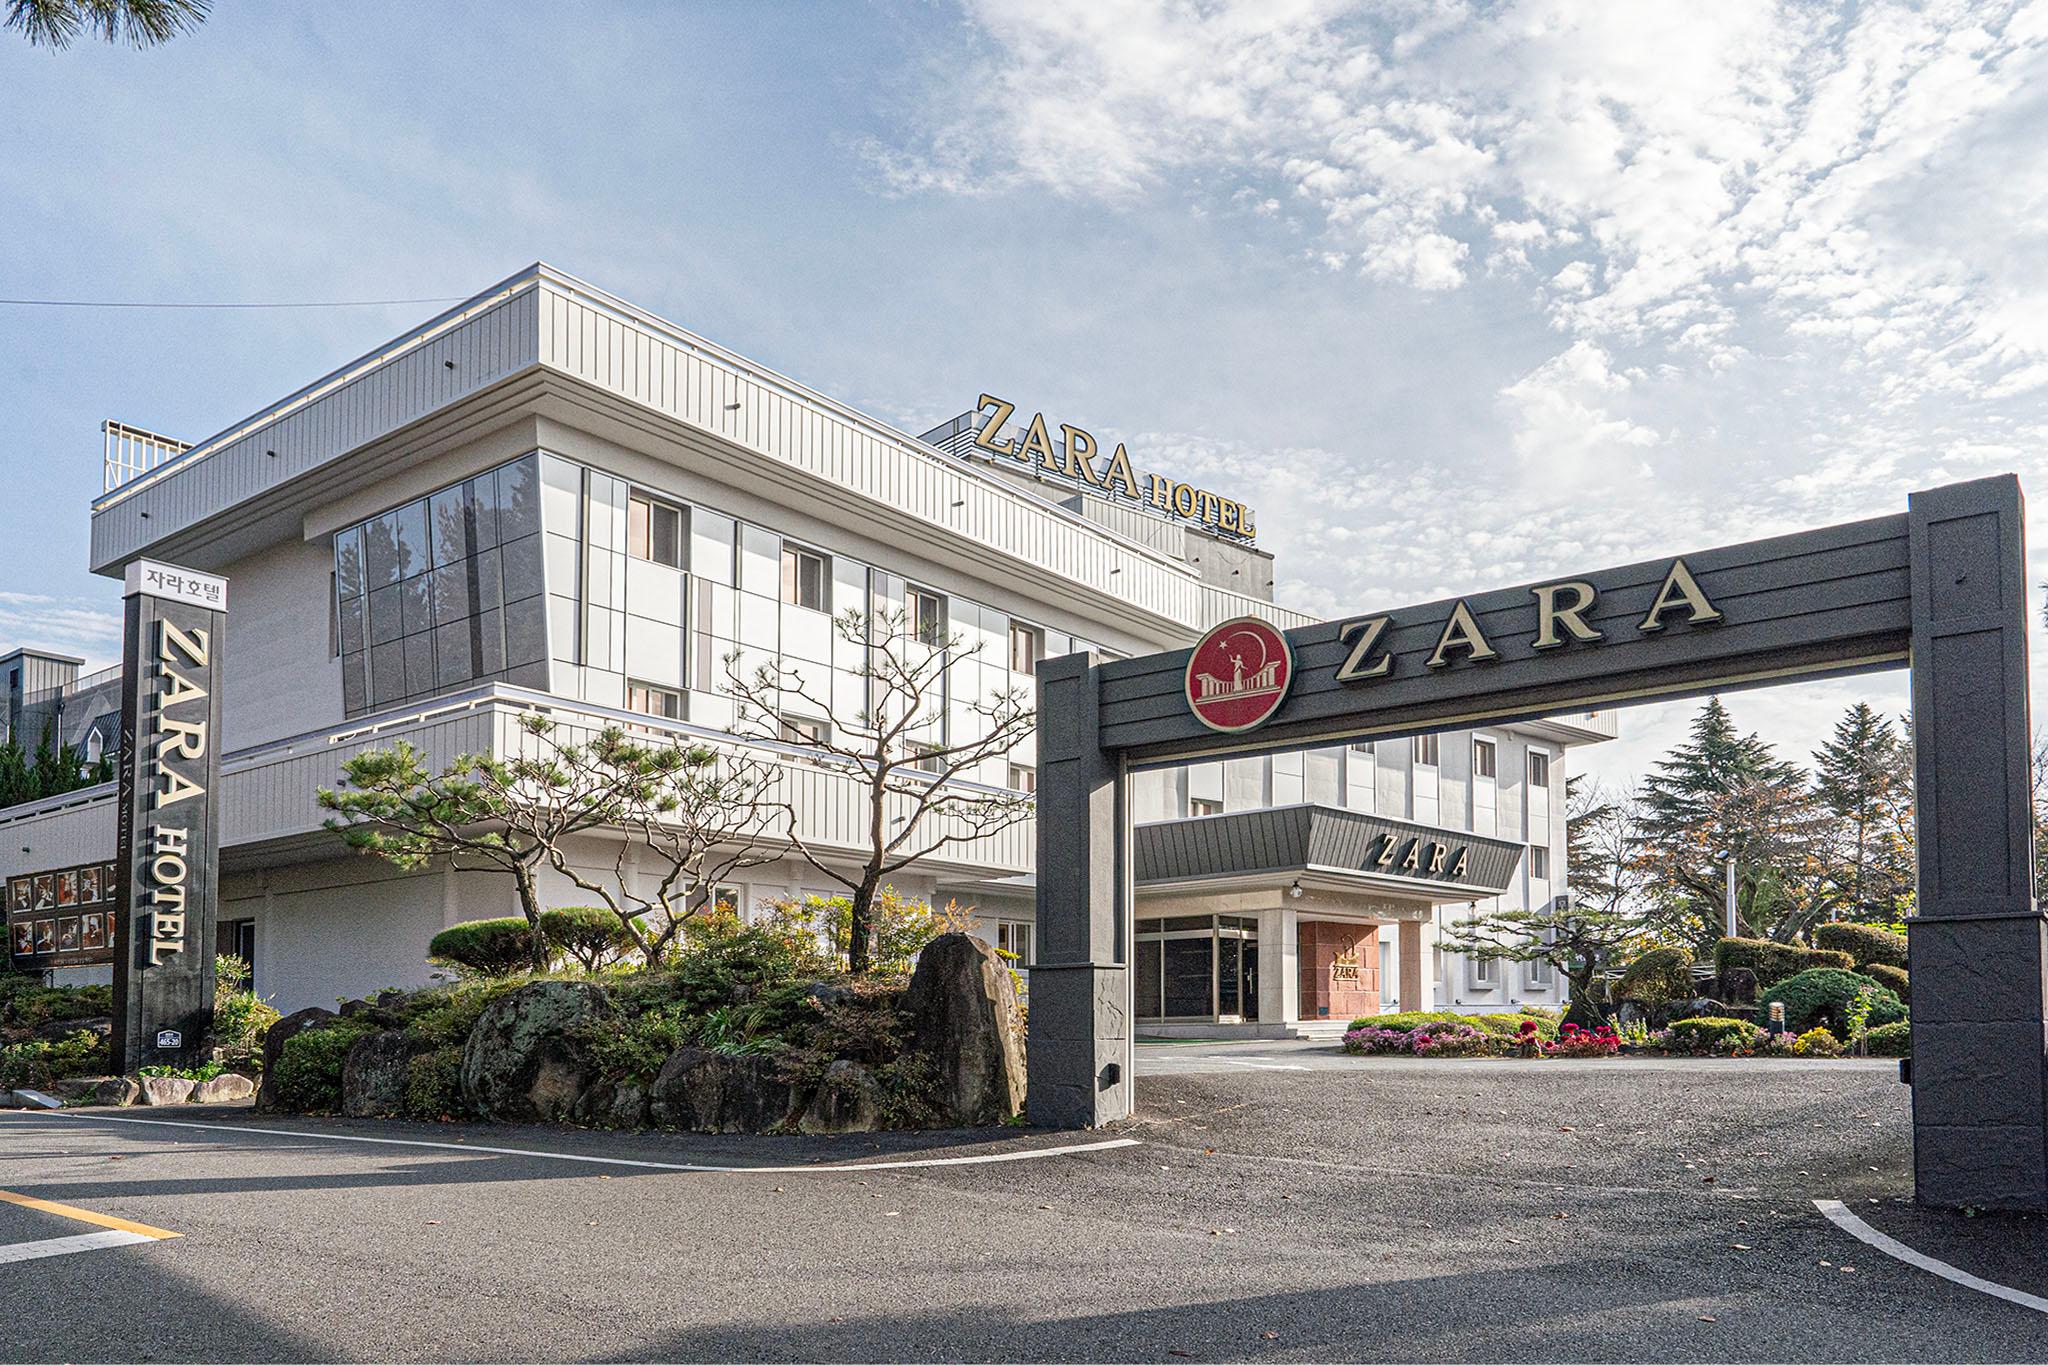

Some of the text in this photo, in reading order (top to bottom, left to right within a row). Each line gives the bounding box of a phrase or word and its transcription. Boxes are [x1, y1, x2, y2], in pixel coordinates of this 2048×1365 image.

[975, 393, 1256, 537] ZARA HOTEL
[147, 570, 219, 602] 자라호텔
[1335, 558, 1724, 682] ZARA
[150, 618, 208, 966] ZARA HOTEL
[1377, 835, 1469, 877] ZARA
[1333, 964, 1359, 979] ZARA
